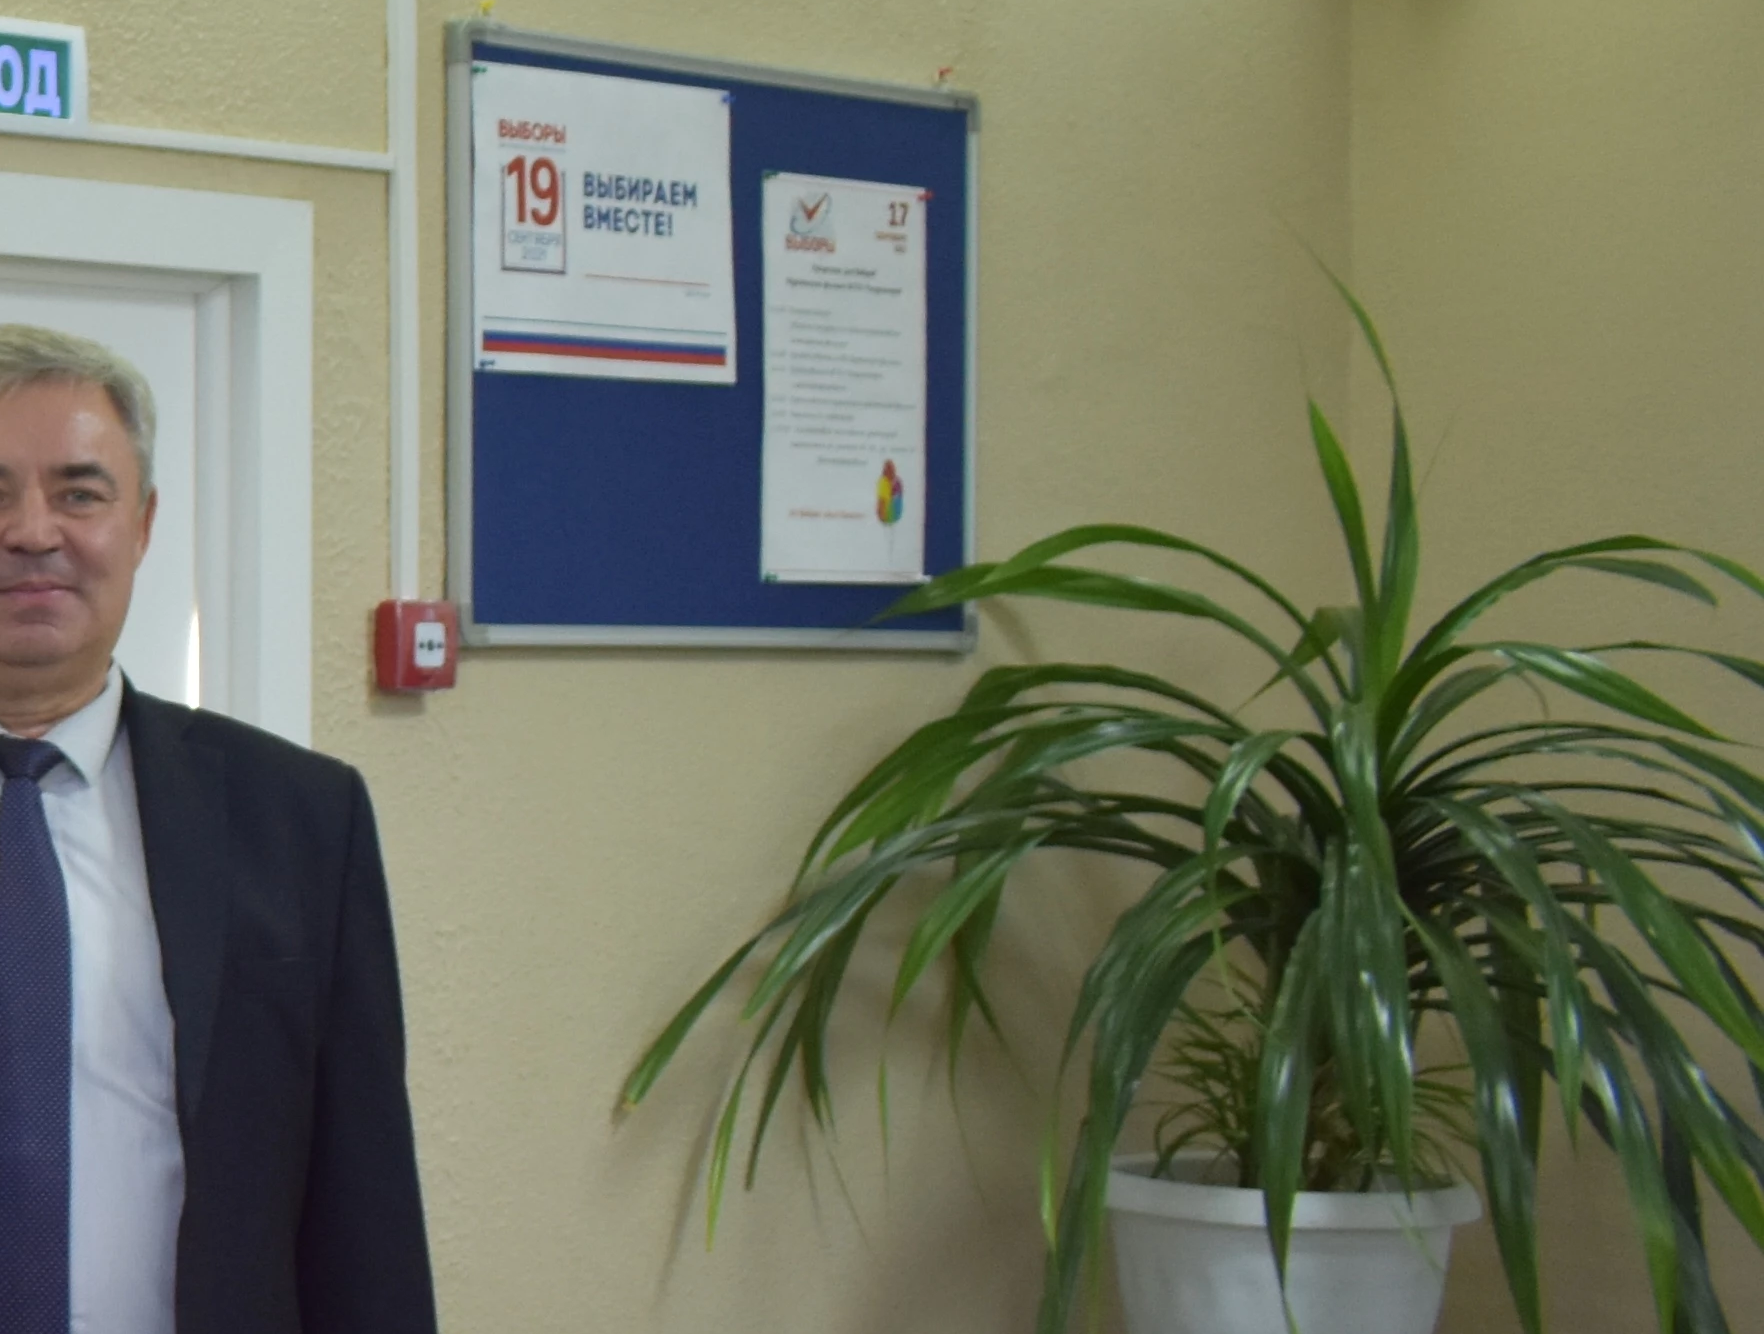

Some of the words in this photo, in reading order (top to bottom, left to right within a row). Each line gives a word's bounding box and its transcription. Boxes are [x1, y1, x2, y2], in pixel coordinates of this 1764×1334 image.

[498, 119, 567, 145] ВЫБОРЫ
[506, 154, 560, 227] 19
[583, 172, 698, 208] ВЫБИРАЕМ
[583, 204, 674, 237] ВМЕСТЕ!
[888, 201, 909, 226] 17
